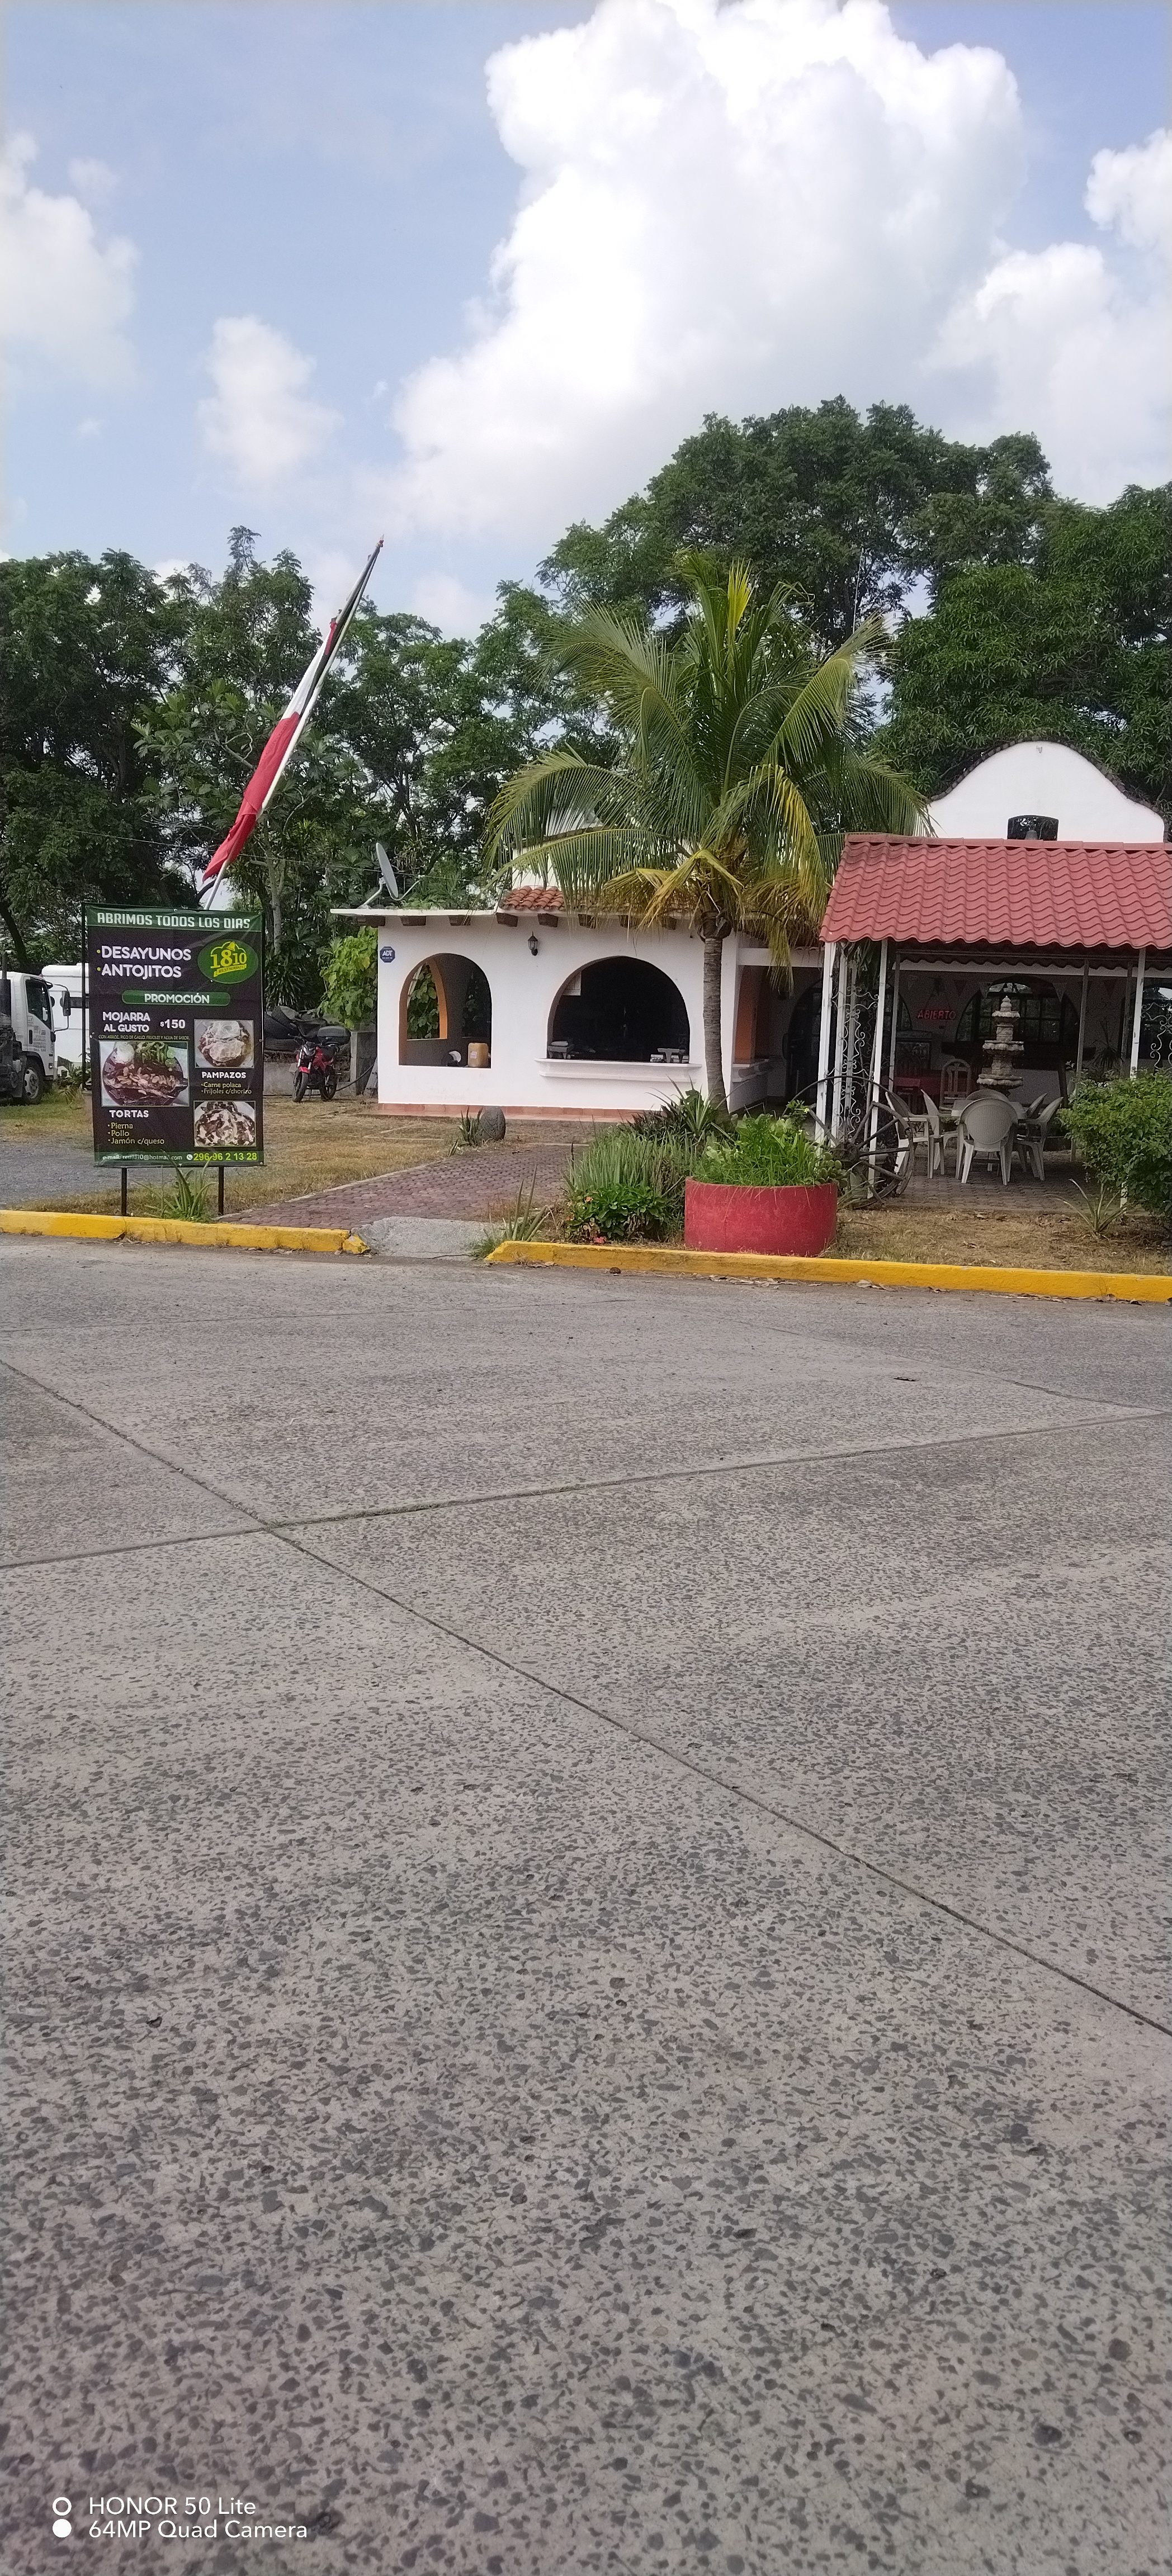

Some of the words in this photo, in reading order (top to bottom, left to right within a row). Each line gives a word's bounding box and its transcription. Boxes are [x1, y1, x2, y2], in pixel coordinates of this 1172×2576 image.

[97, 912, 152, 926] ABRIMOS
[155, 915, 195, 927] TODOS
[199, 917, 220, 928] LOS
[224, 918, 251, 929] DIAS
[101, 945, 191, 961] DESAYUNOS
[210, 949, 247, 969] 1810
[101, 963, 182, 979] ANTOJITOS
[144, 993, 210, 1004] PROMOCIÓN
[102, 1011, 150, 1023] MOJARRA
[918, 1010, 956, 1020] ABIERTO
[103, 1024, 116, 1032] AL
[117, 1024, 150, 1033] GUSTO
[160, 1019, 186, 1029] $150
[109, 1110, 149, 1118] TORTAS
[137, 1138, 165, 1146] c/queso
